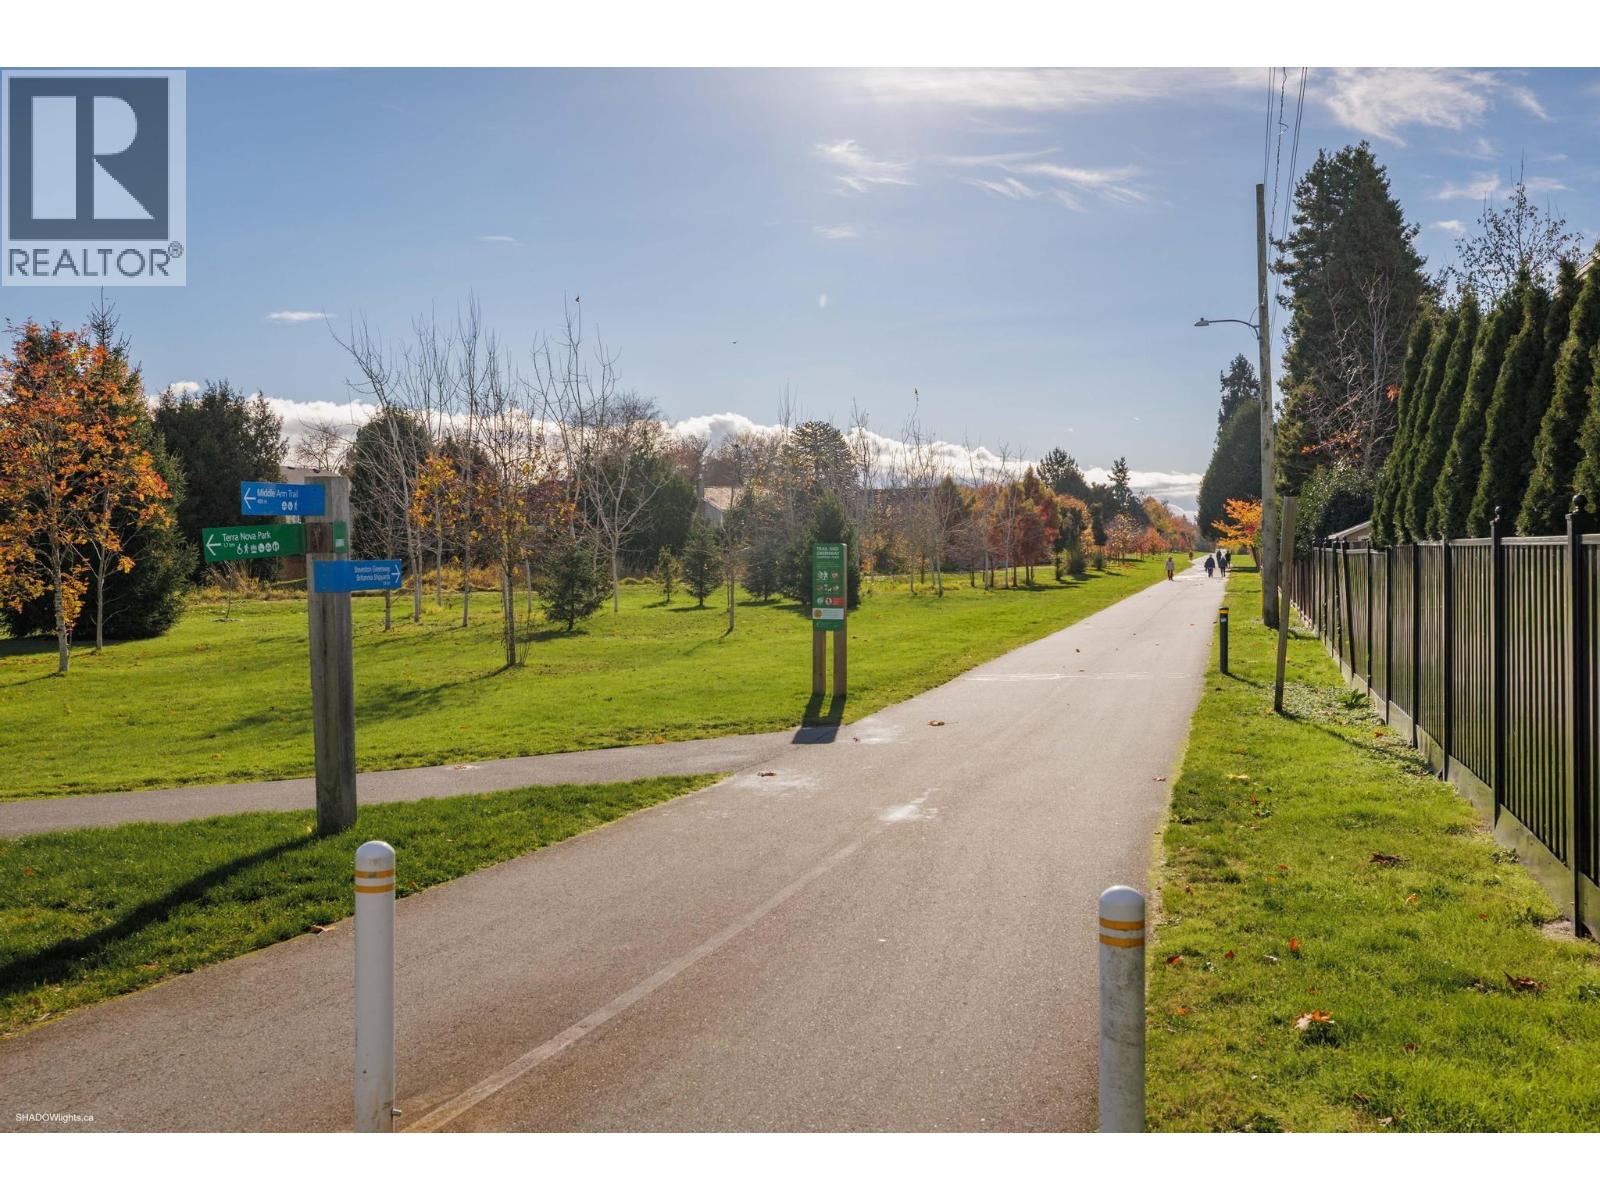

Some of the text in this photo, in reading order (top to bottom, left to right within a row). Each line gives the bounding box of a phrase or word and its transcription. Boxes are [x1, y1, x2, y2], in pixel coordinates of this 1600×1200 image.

[257, 488, 298, 498] Middle Arm Trail
[222, 531, 272, 542] Terra Nova Park
